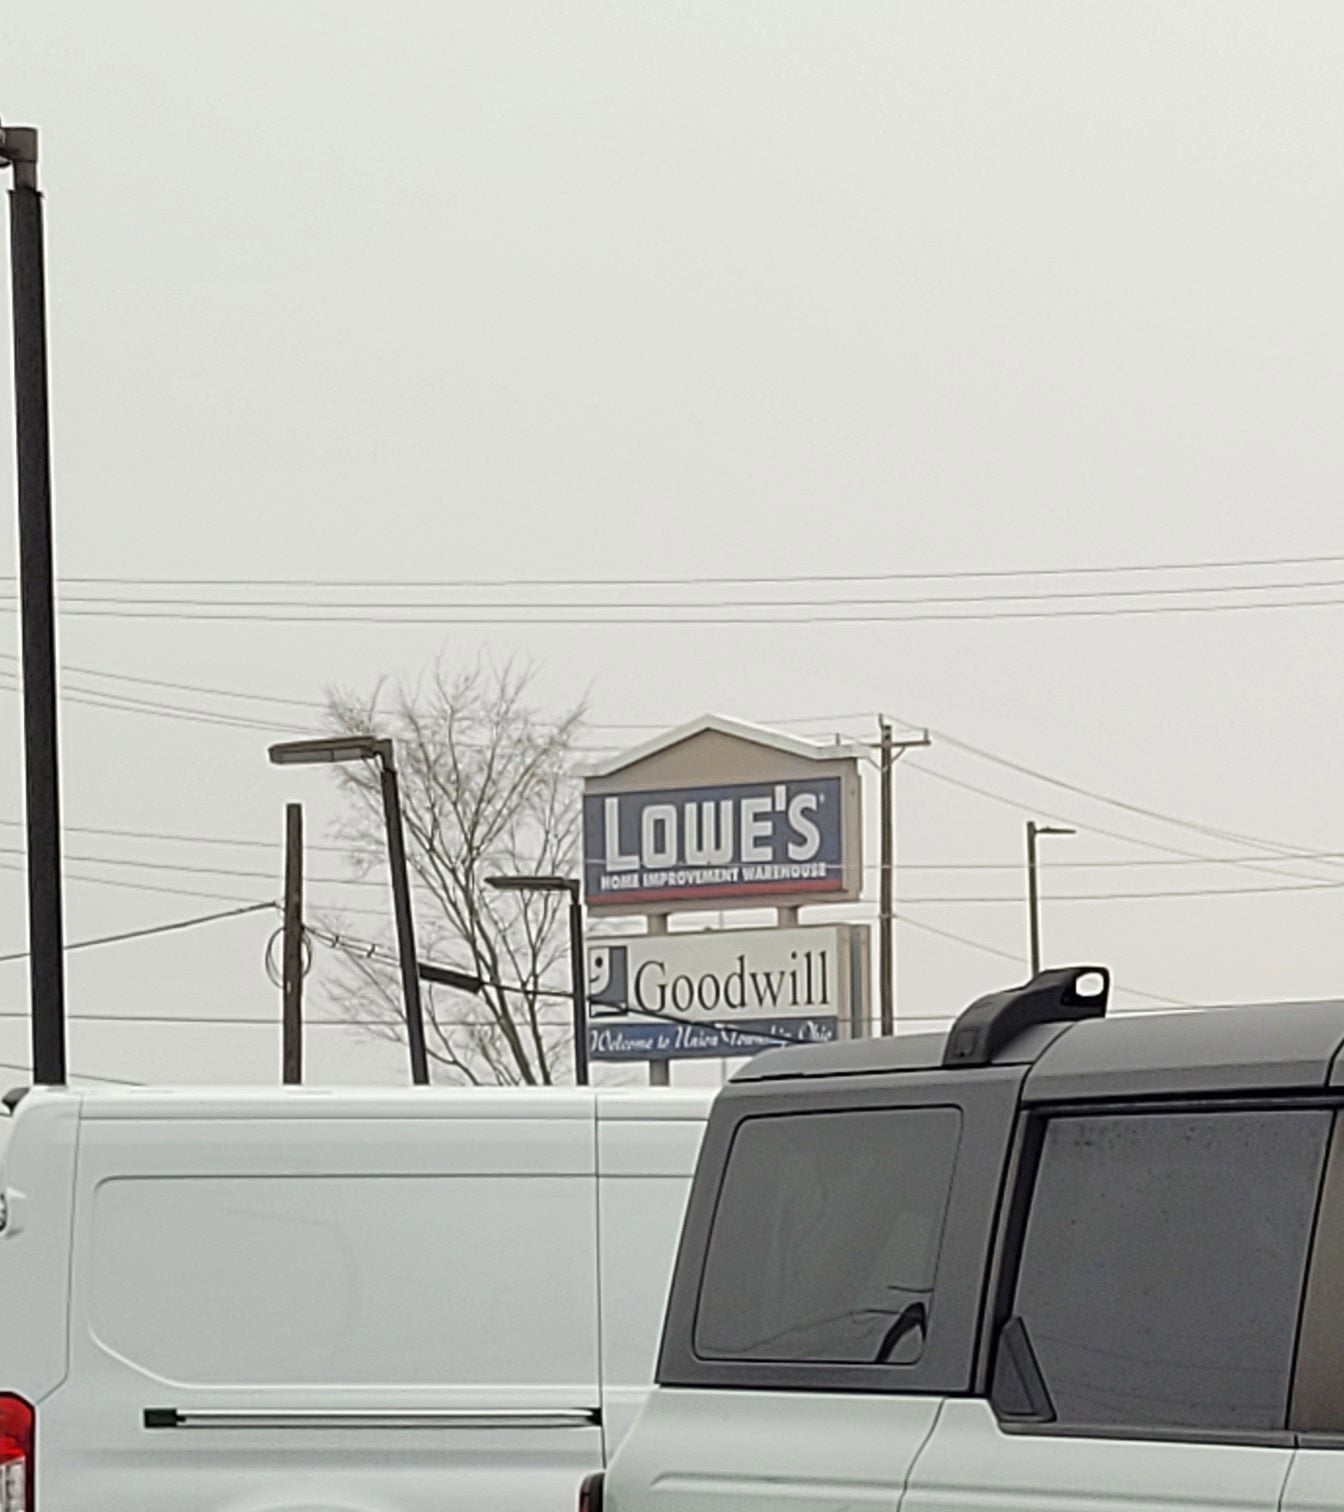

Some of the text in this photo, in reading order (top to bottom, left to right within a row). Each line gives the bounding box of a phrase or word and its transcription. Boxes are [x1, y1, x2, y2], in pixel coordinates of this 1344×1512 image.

[604, 785, 821, 872] LOWE'S
[601, 861, 827, 891] HOME IMPROVEMENT WAREHOUSE
[635, 951, 831, 1013] Goodwill
[591, 1028, 653, 1052] Welcome
[657, 1034, 670, 1050] to
